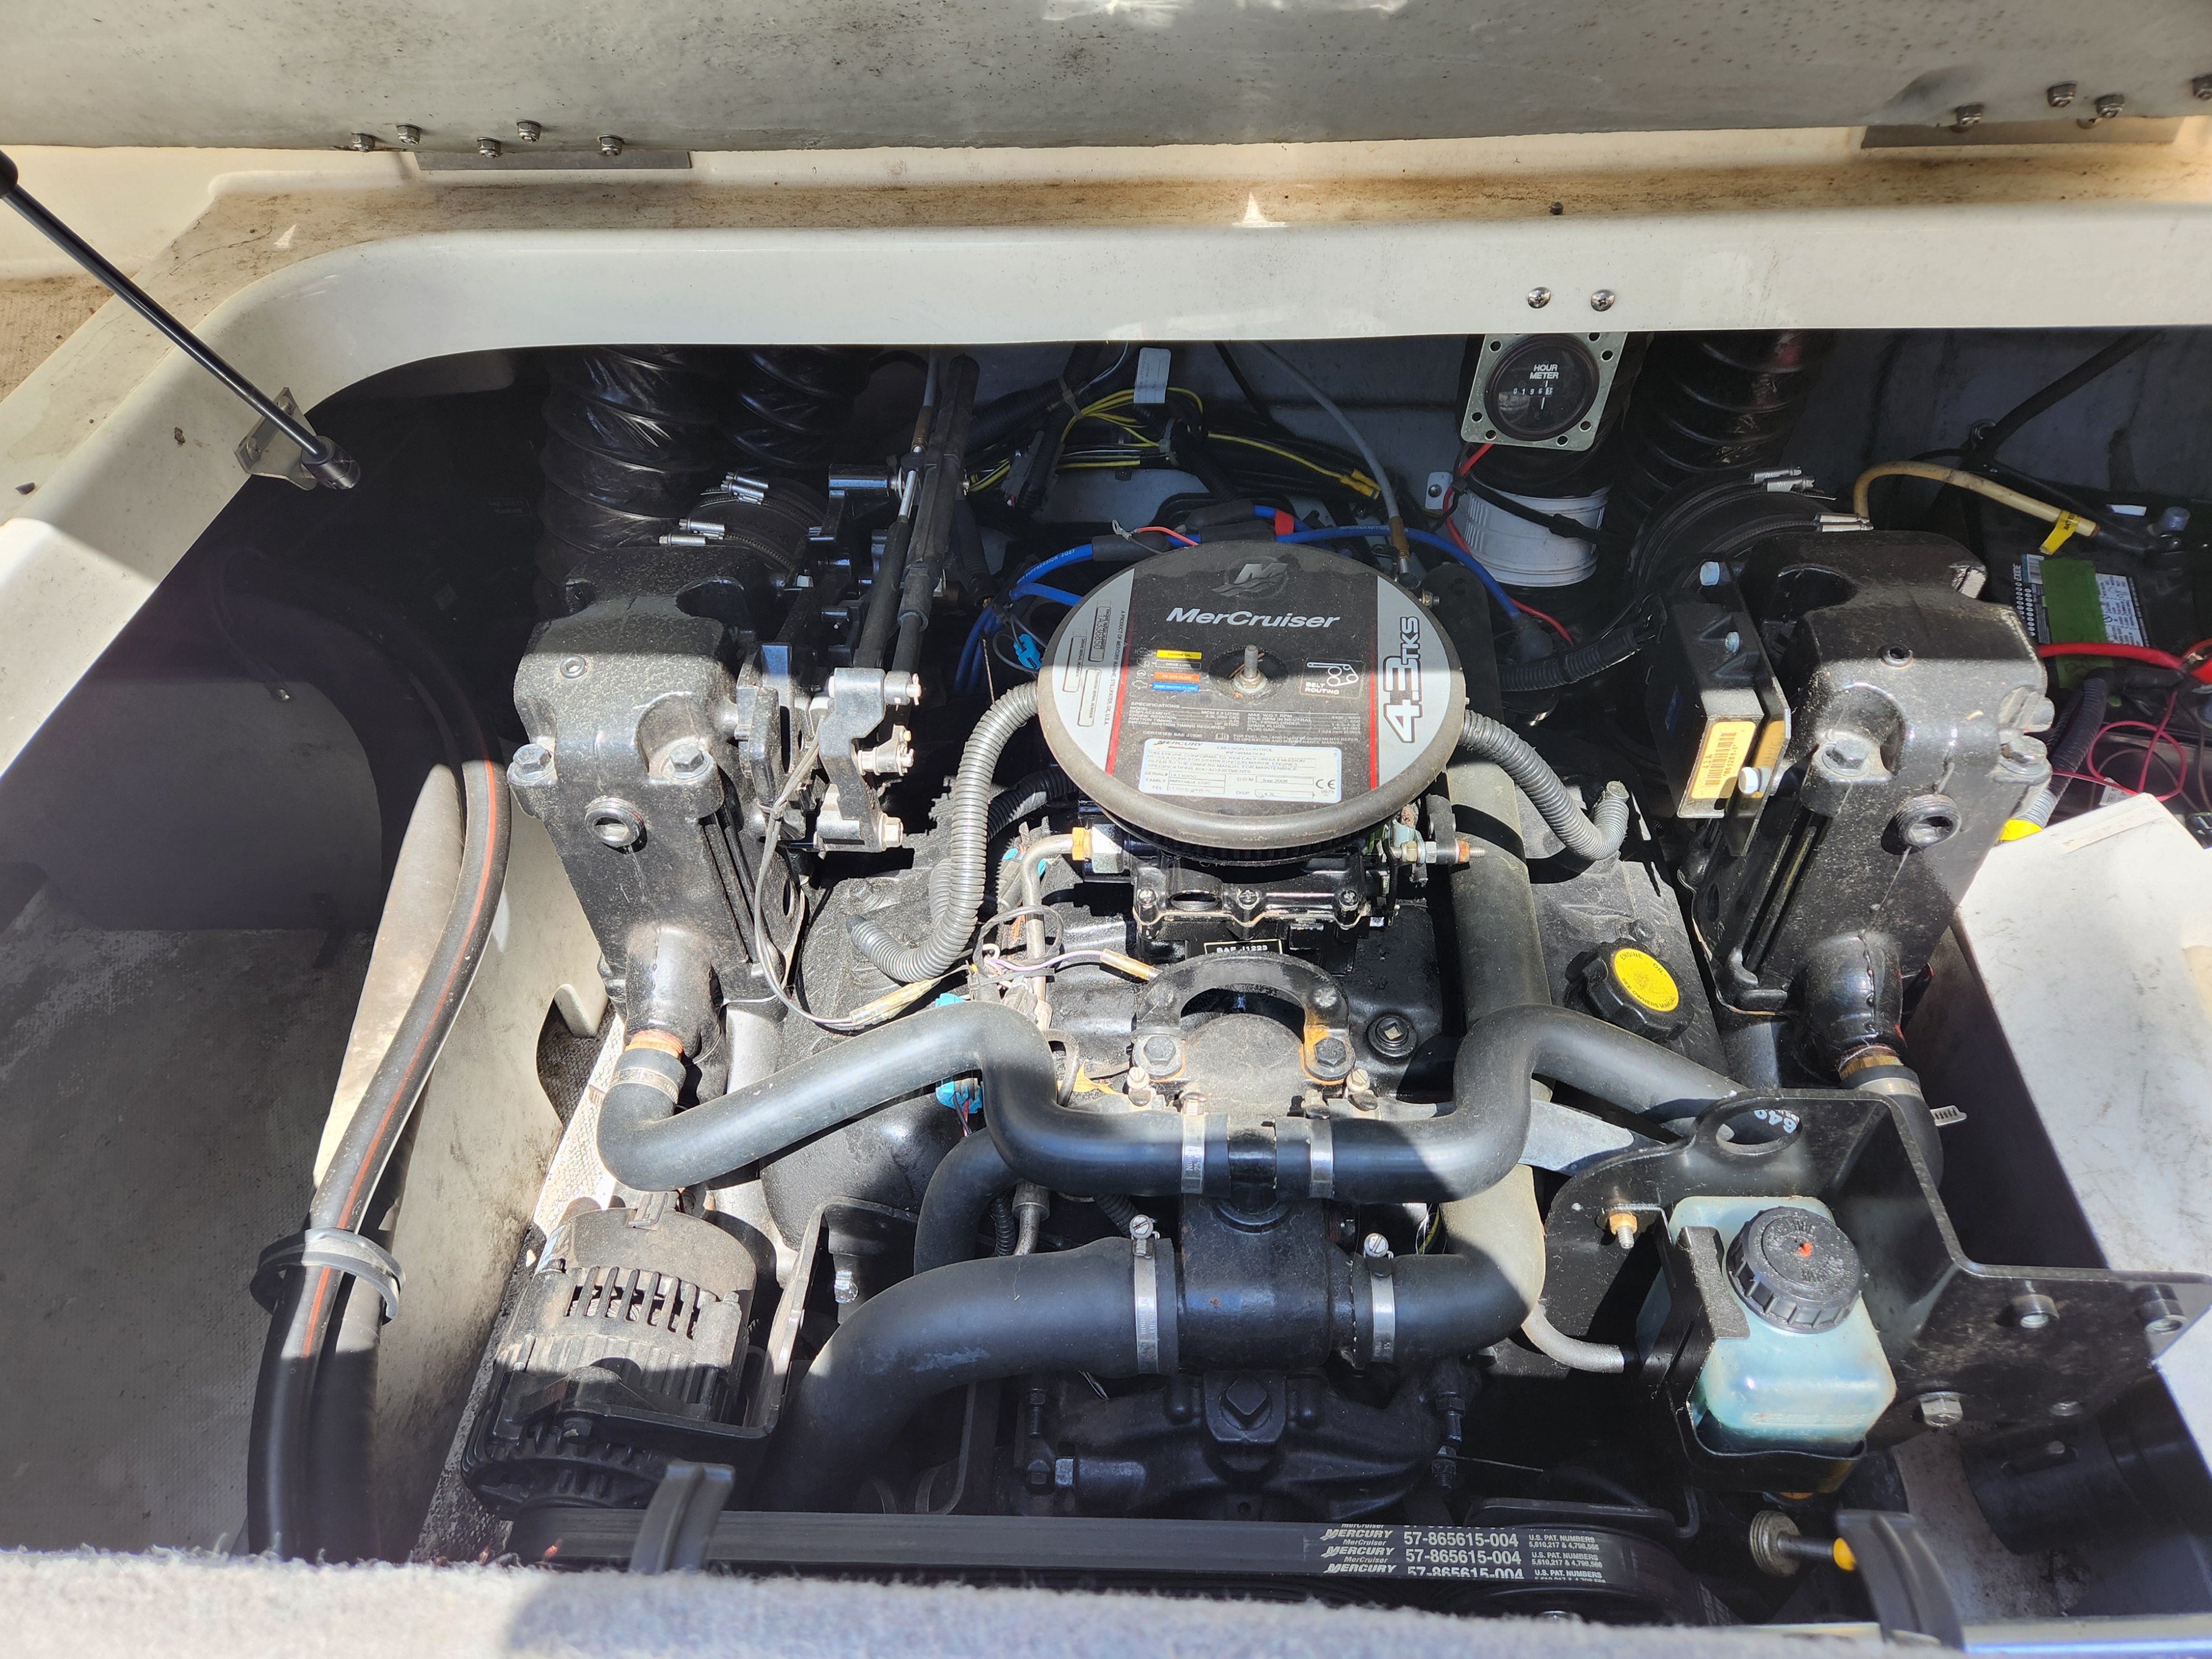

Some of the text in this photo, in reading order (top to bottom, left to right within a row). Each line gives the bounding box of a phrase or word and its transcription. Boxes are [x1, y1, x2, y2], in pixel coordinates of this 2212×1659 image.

[1166, 607, 1341, 628] MerCruiser
[1093, 614, 1105, 649] 1A336850
[1620, 952, 1643, 961] ENGINE
[1621, 977, 1676, 1009] SEE OWNERS MANUAL
[1319, 1529, 1394, 1541] MERCURY
[1404, 1531, 1519, 1547] 57-865615-004
[1321, 1546, 1395, 1558] MERCURY
[1406, 1548, 1522, 1564] 57-865615-004
[1323, 1563, 1397, 1573] MERCURY
[1566, 1570, 1602, 1578] NUMBERS
